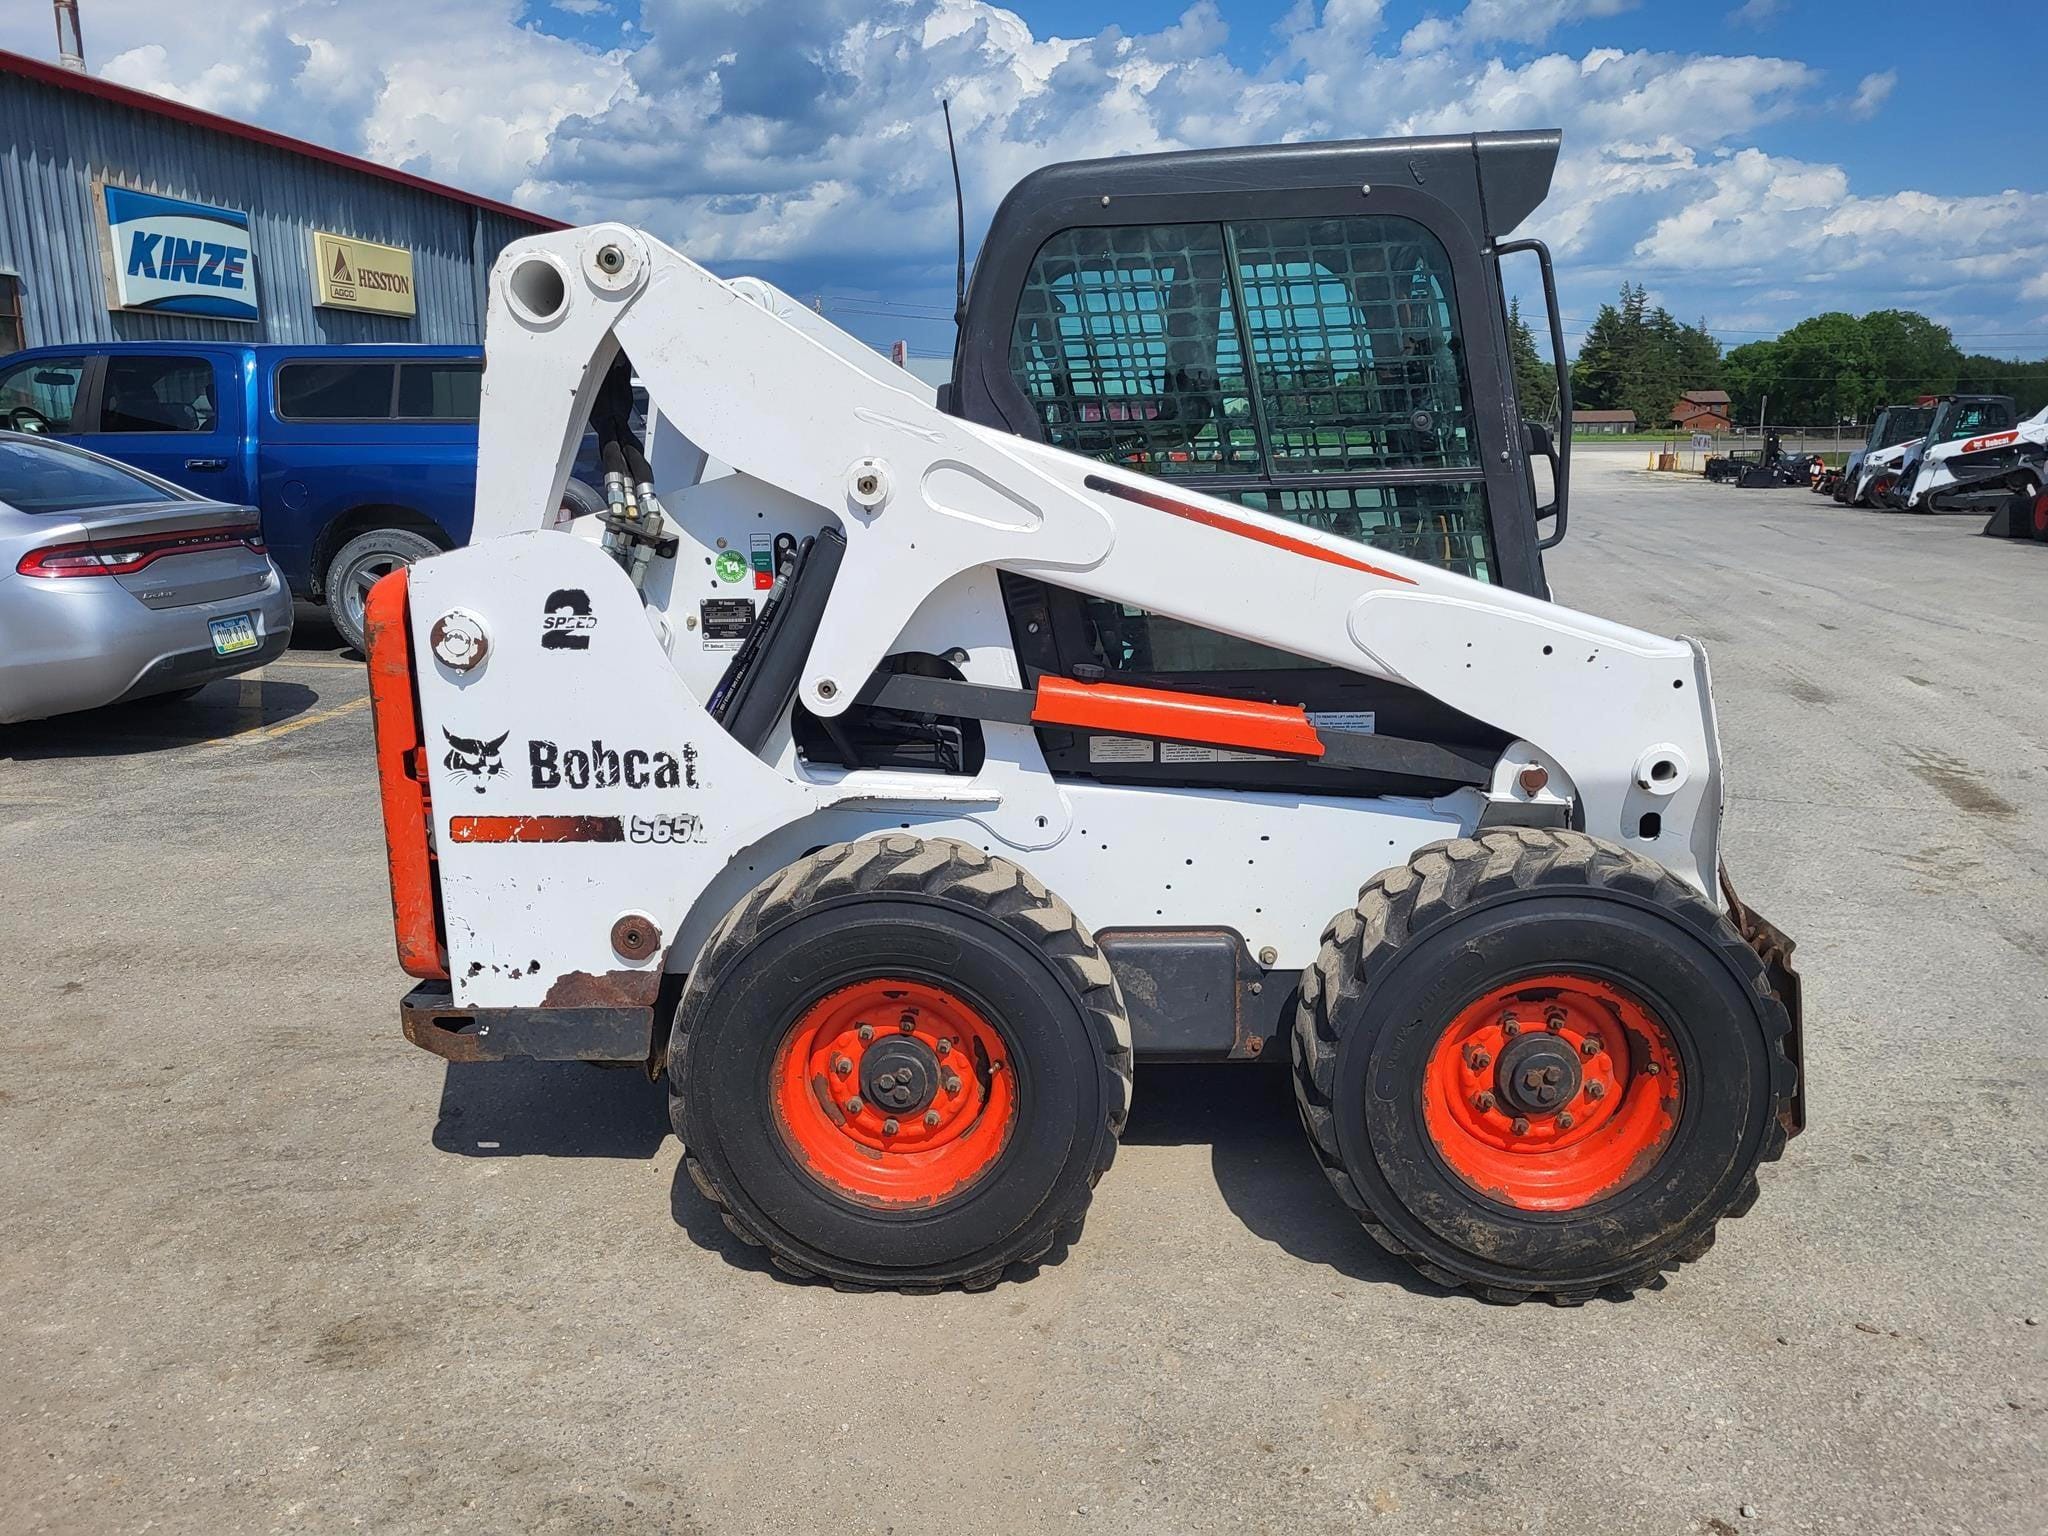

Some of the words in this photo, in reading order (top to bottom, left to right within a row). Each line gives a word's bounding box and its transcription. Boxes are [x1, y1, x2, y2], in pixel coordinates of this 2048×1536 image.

[127, 230, 248, 290] KINZE
[334, 287, 355, 299] AGCO
[357, 267, 410, 295] HESSTON
[543, 616, 598, 629] SPEED
[528, 740, 700, 790] Bobcat
